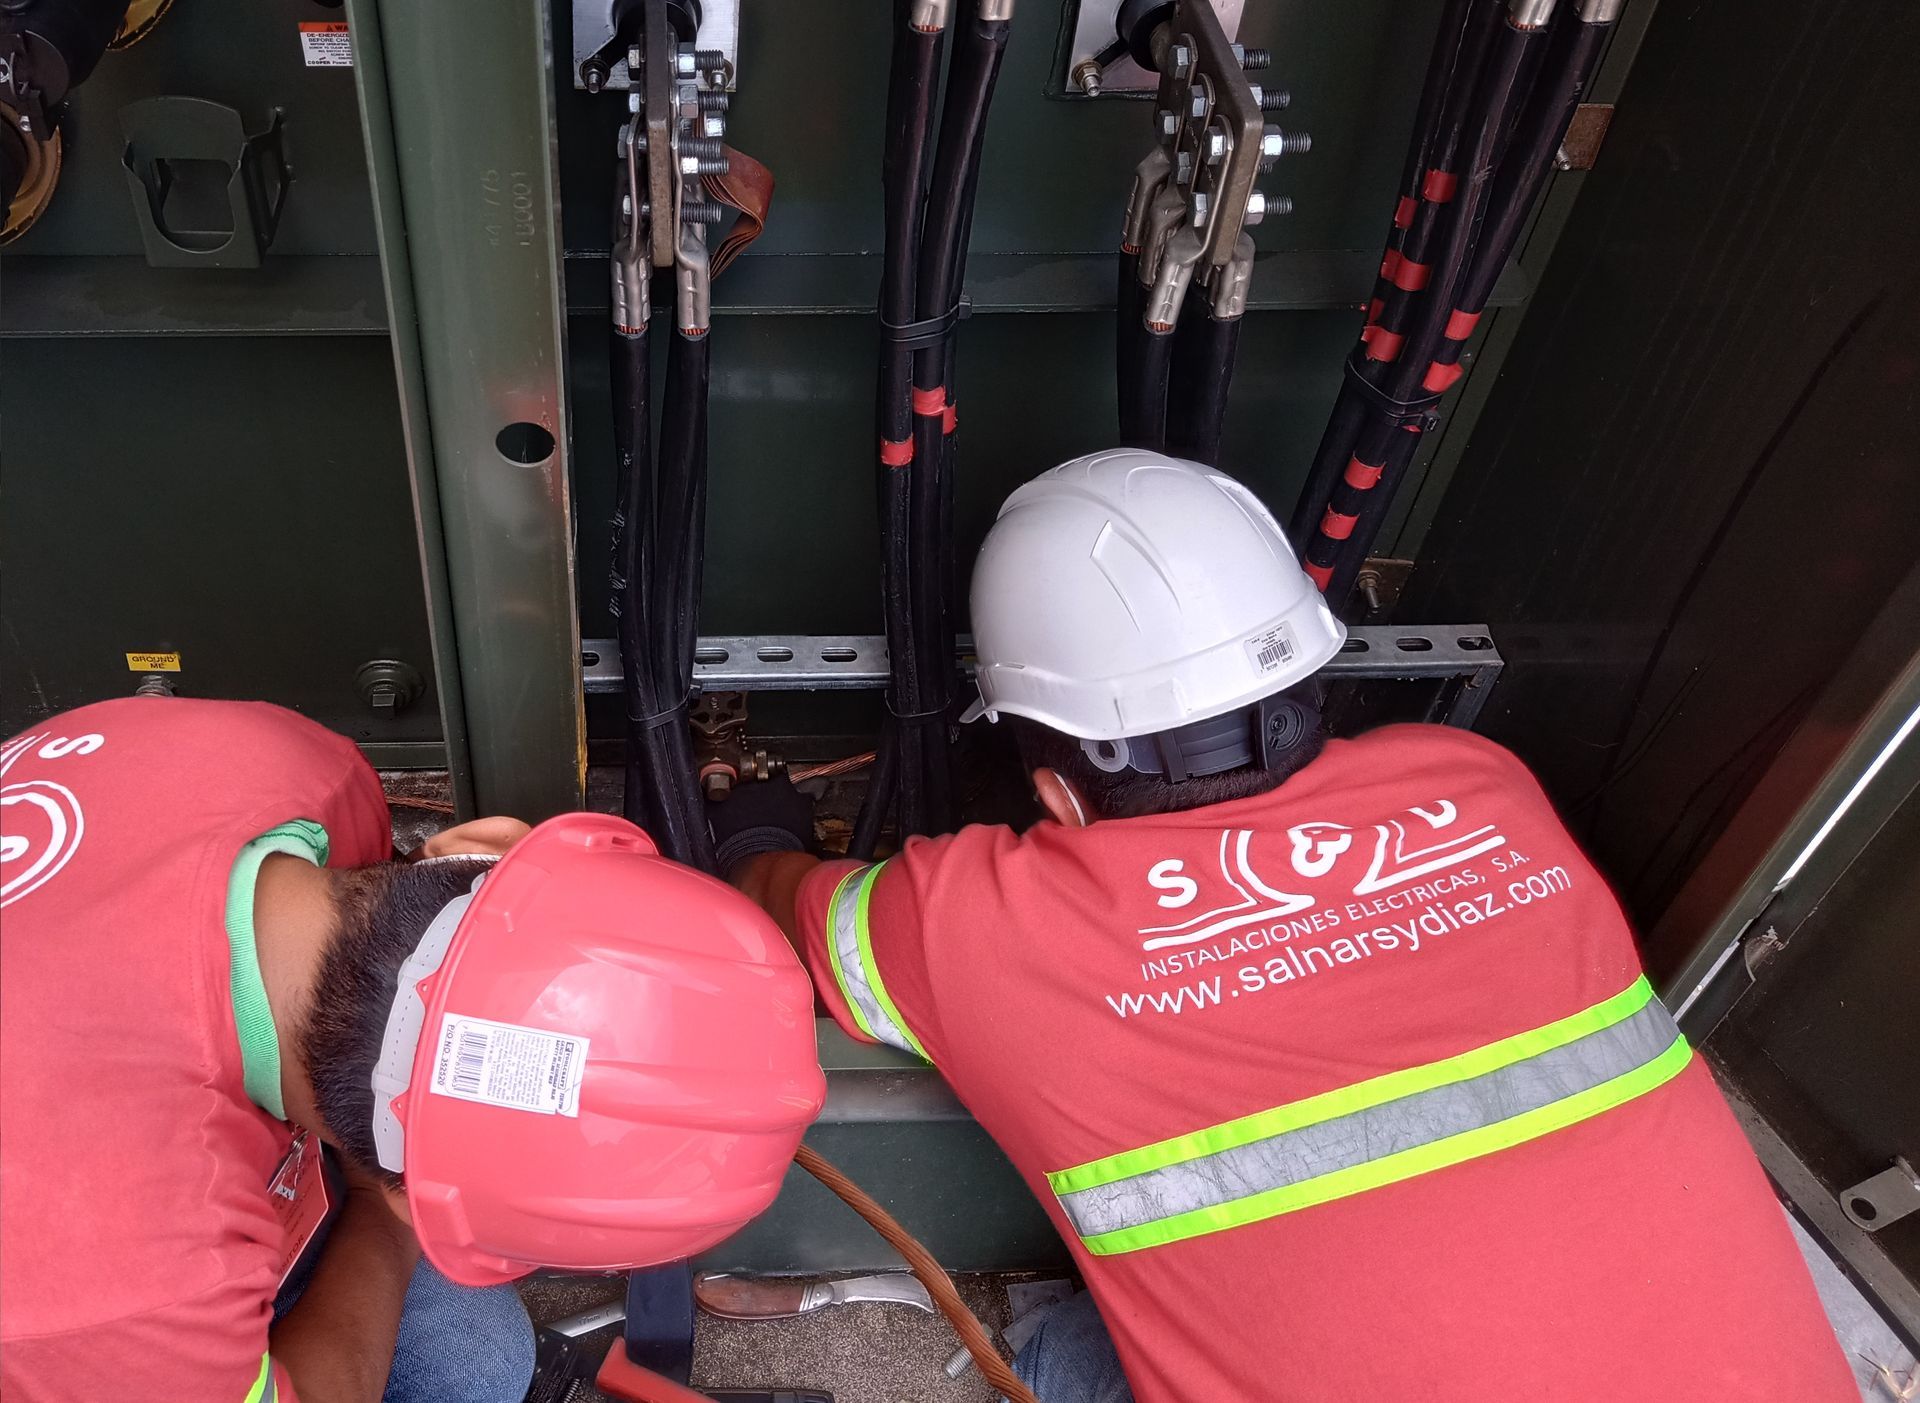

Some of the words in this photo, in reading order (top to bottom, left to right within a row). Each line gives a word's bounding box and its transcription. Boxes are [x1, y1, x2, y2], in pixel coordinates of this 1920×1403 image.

[131, 655, 177, 663] GROUND
[1147, 858, 1199, 909] S
[1142, 909, 1340, 981] INSTALACIONES
[1345, 869, 1486, 922] ELECTRICAS,
[1491, 850, 1531, 873] S.A.
[1105, 865, 1572, 1018] www.salnarsydiaz.com
[447, 1024, 455, 1039] P/O
[442, 1040, 451, 1056] NO.
[437, 1057, 449, 1086] 352520
